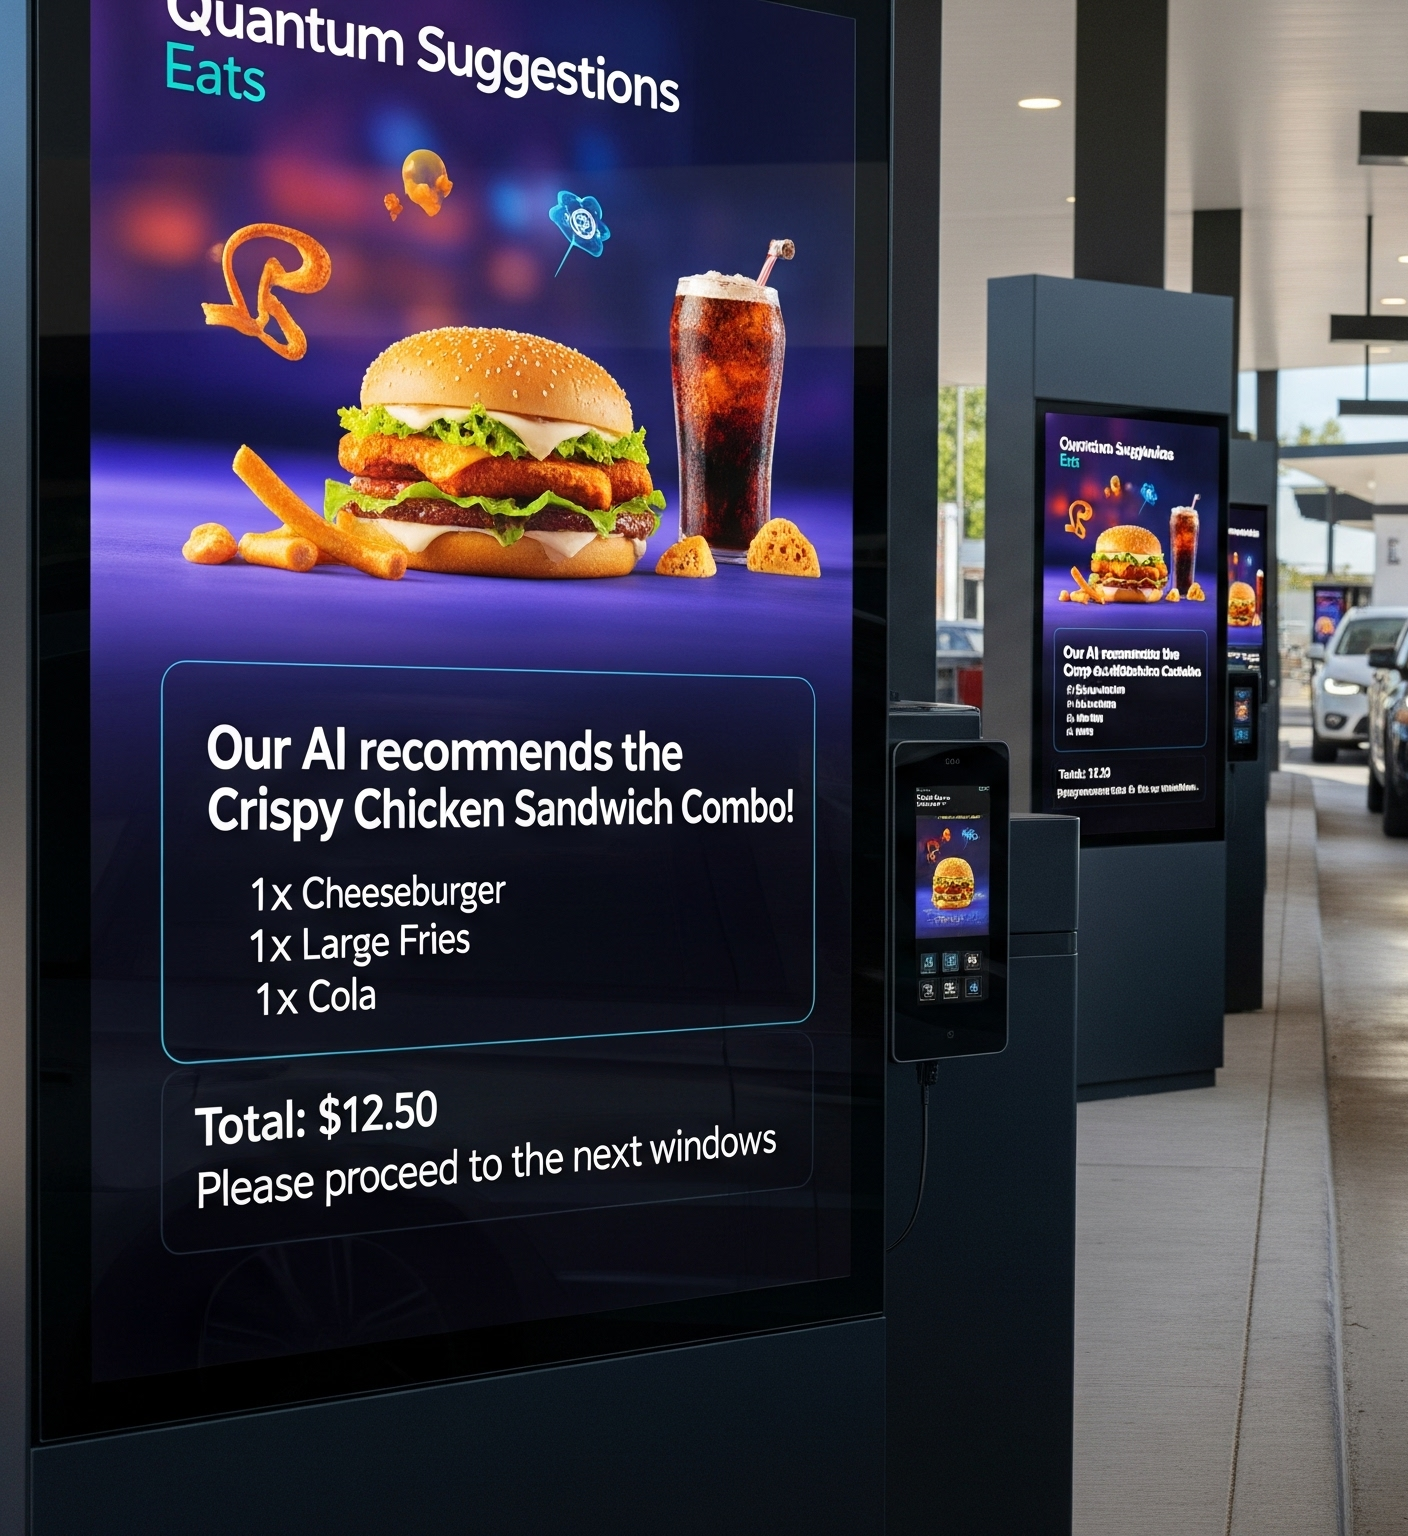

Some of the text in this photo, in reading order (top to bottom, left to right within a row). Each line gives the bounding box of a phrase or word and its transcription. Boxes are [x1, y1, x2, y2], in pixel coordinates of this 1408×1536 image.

[166, 0, 680, 113] Quantum Suggestions
[166, 41, 266, 102] Eats
[207, 723, 683, 772] Our AI recommends the
[208, 785, 794, 842] Crispy Chicken Sandwich Combo!
[251, 874, 507, 914] 1x Cheeseburger
[250, 922, 471, 968] 1x Large Fries
[256, 976, 376, 1016] 1x Cola
[194, 1089, 438, 1147] Total: $12.50
[198, 1124, 777, 1209] Please proceed to the next windows
